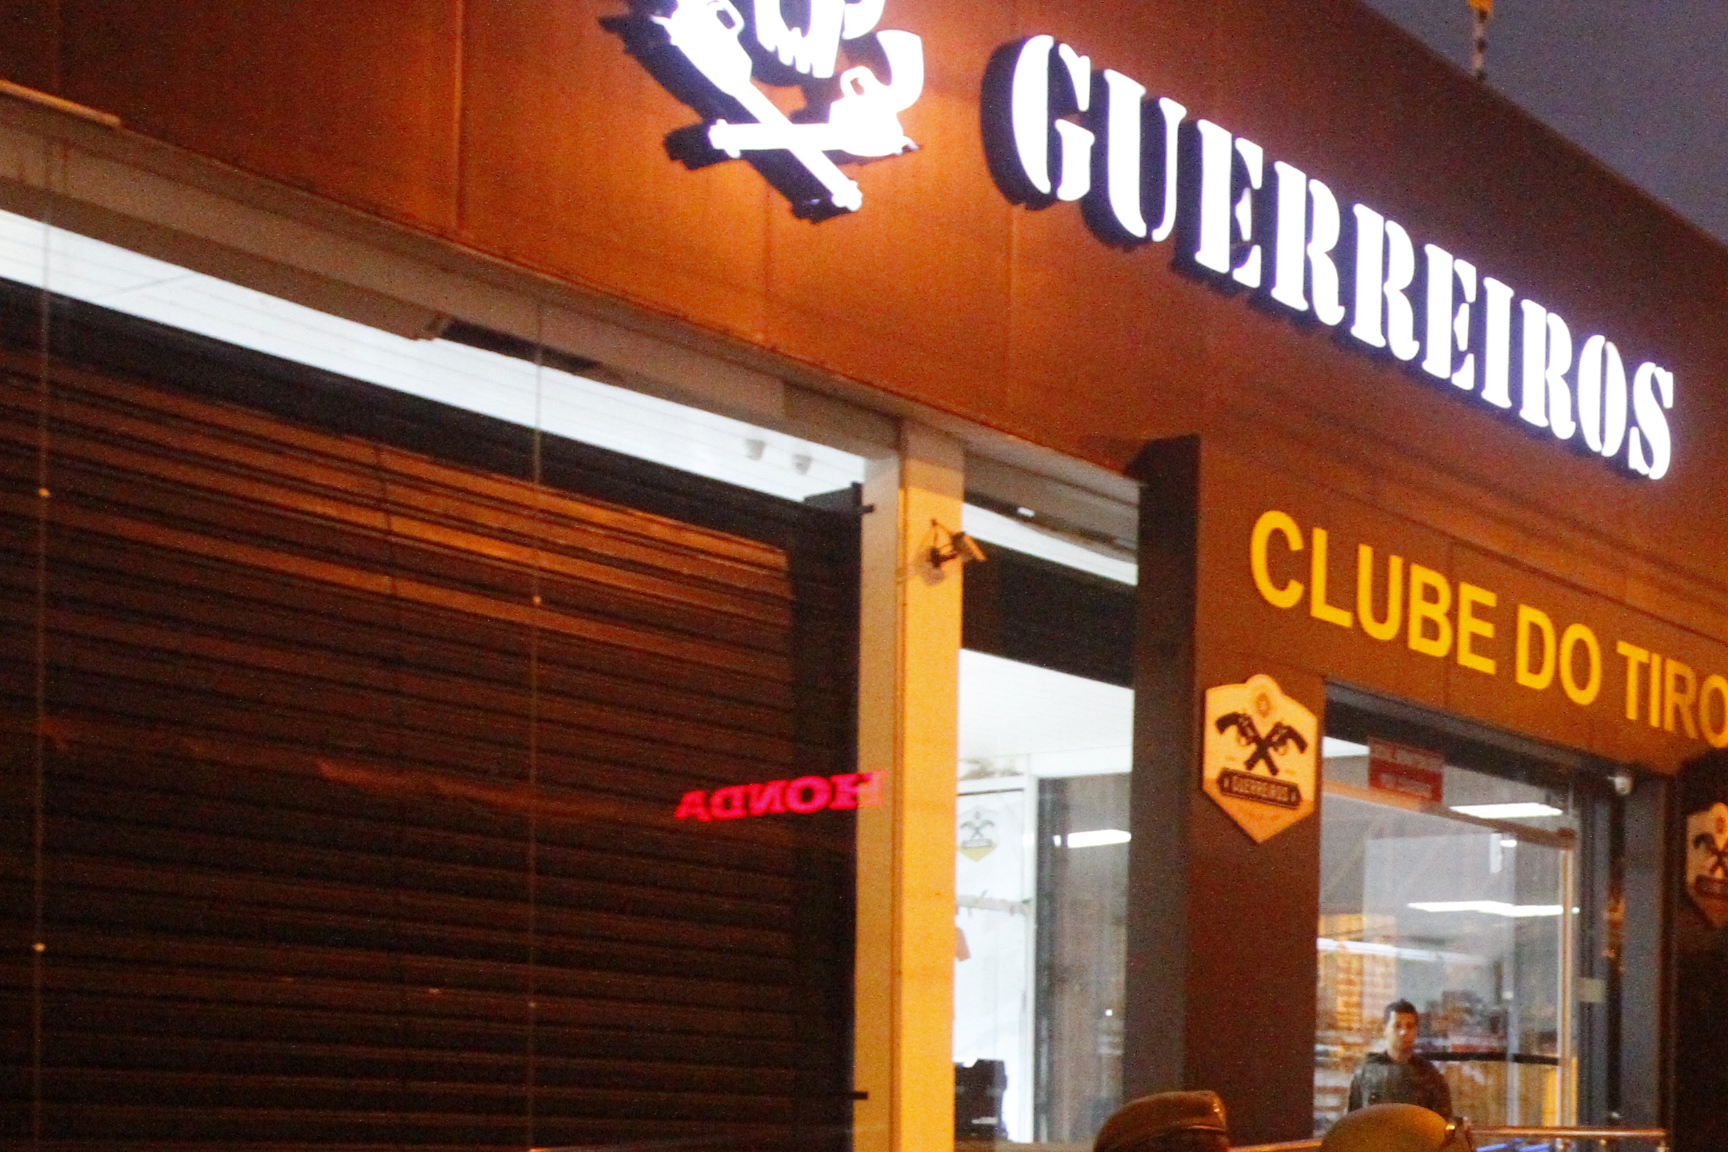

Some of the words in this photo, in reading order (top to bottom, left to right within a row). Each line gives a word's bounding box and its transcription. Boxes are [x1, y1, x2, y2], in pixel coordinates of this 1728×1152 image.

[1011, 33, 1675, 481] GUERREIROS
[1250, 509, 1497, 676] CLUBE
[1515, 606, 1603, 707] DO
